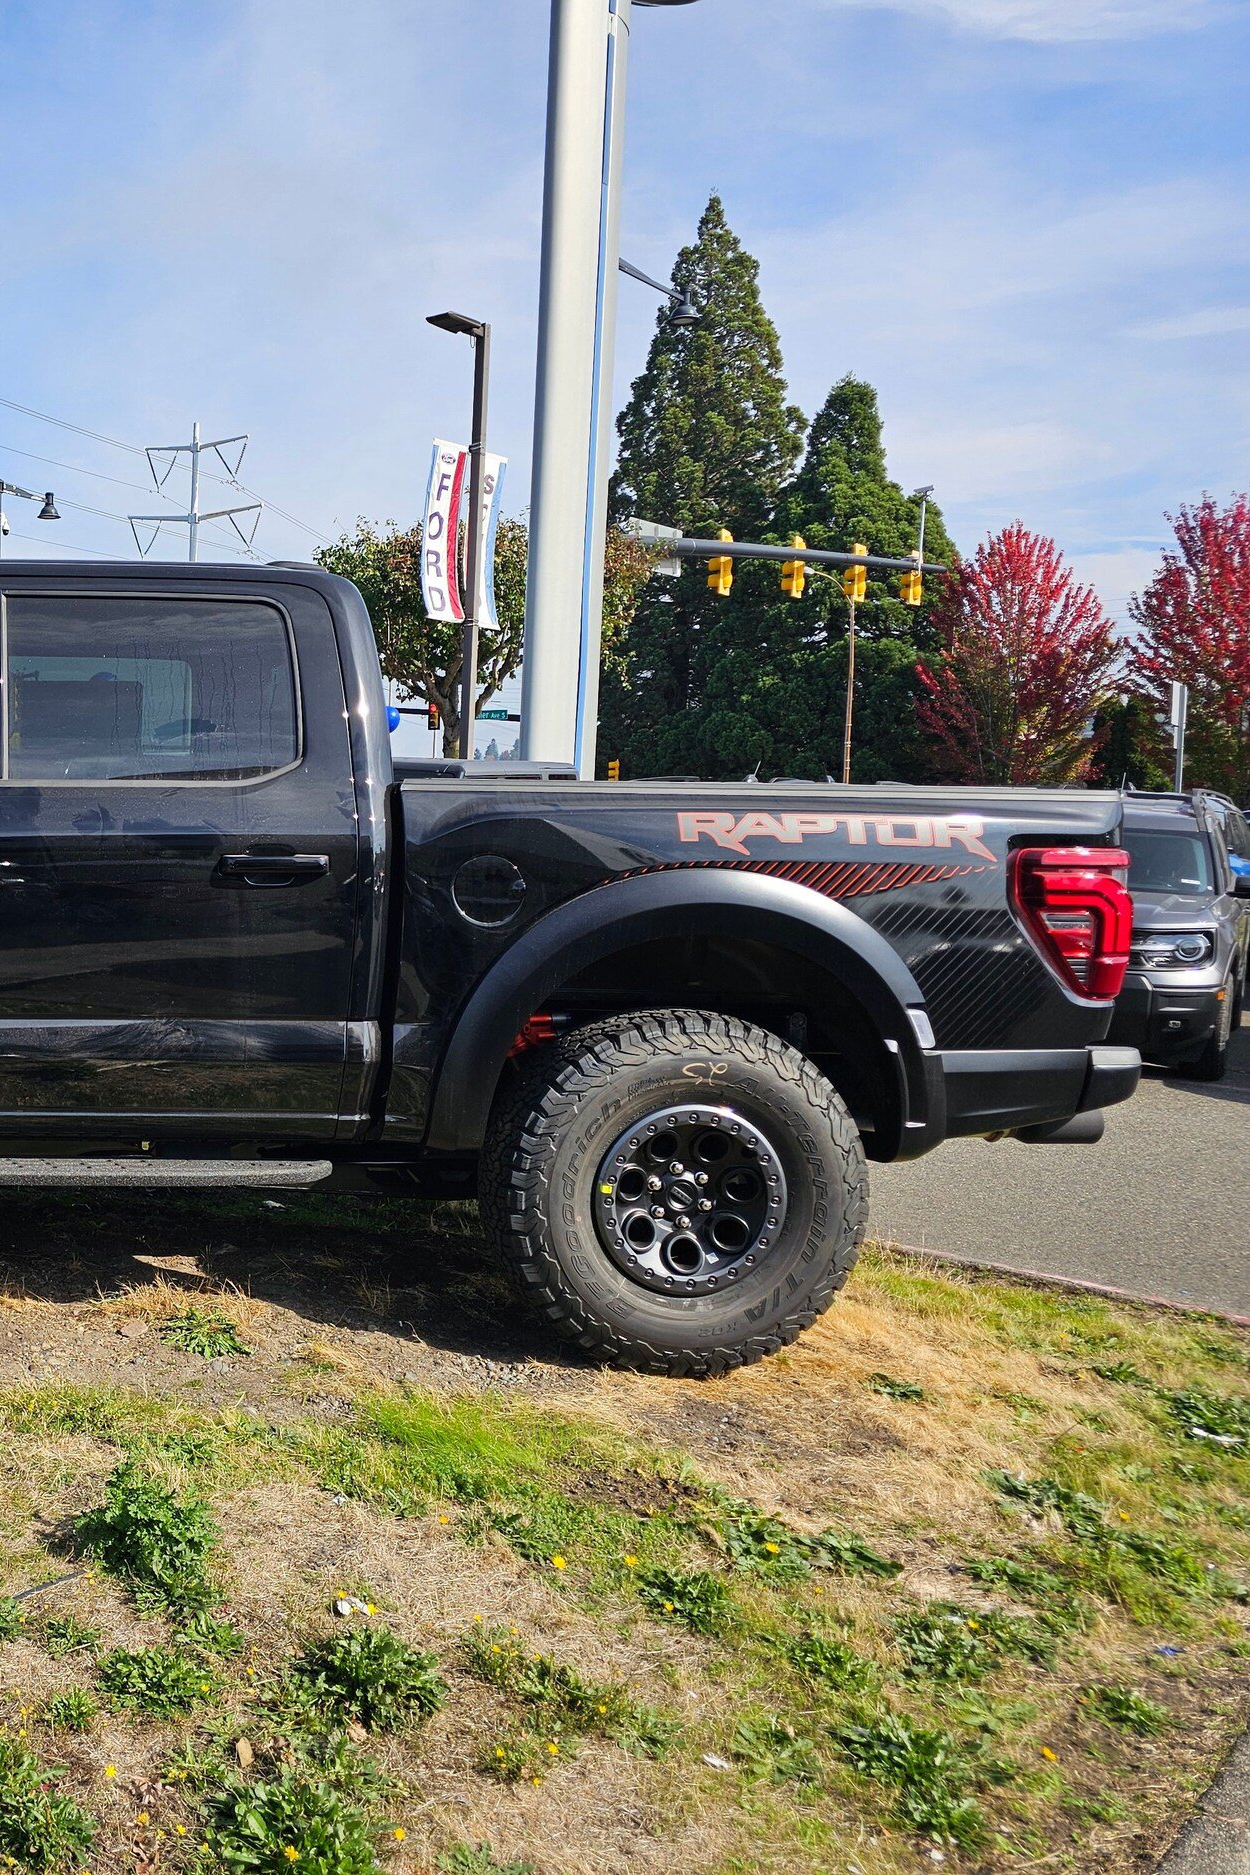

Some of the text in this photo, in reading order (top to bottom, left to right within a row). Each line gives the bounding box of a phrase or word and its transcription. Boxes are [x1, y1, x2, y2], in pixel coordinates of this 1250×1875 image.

[426, 472, 452, 612] FORD
[501, 711, 506, 719] S
[677, 812, 998, 863] RAPTOR
[560, 1098, 638, 1321] BFGoodrich
